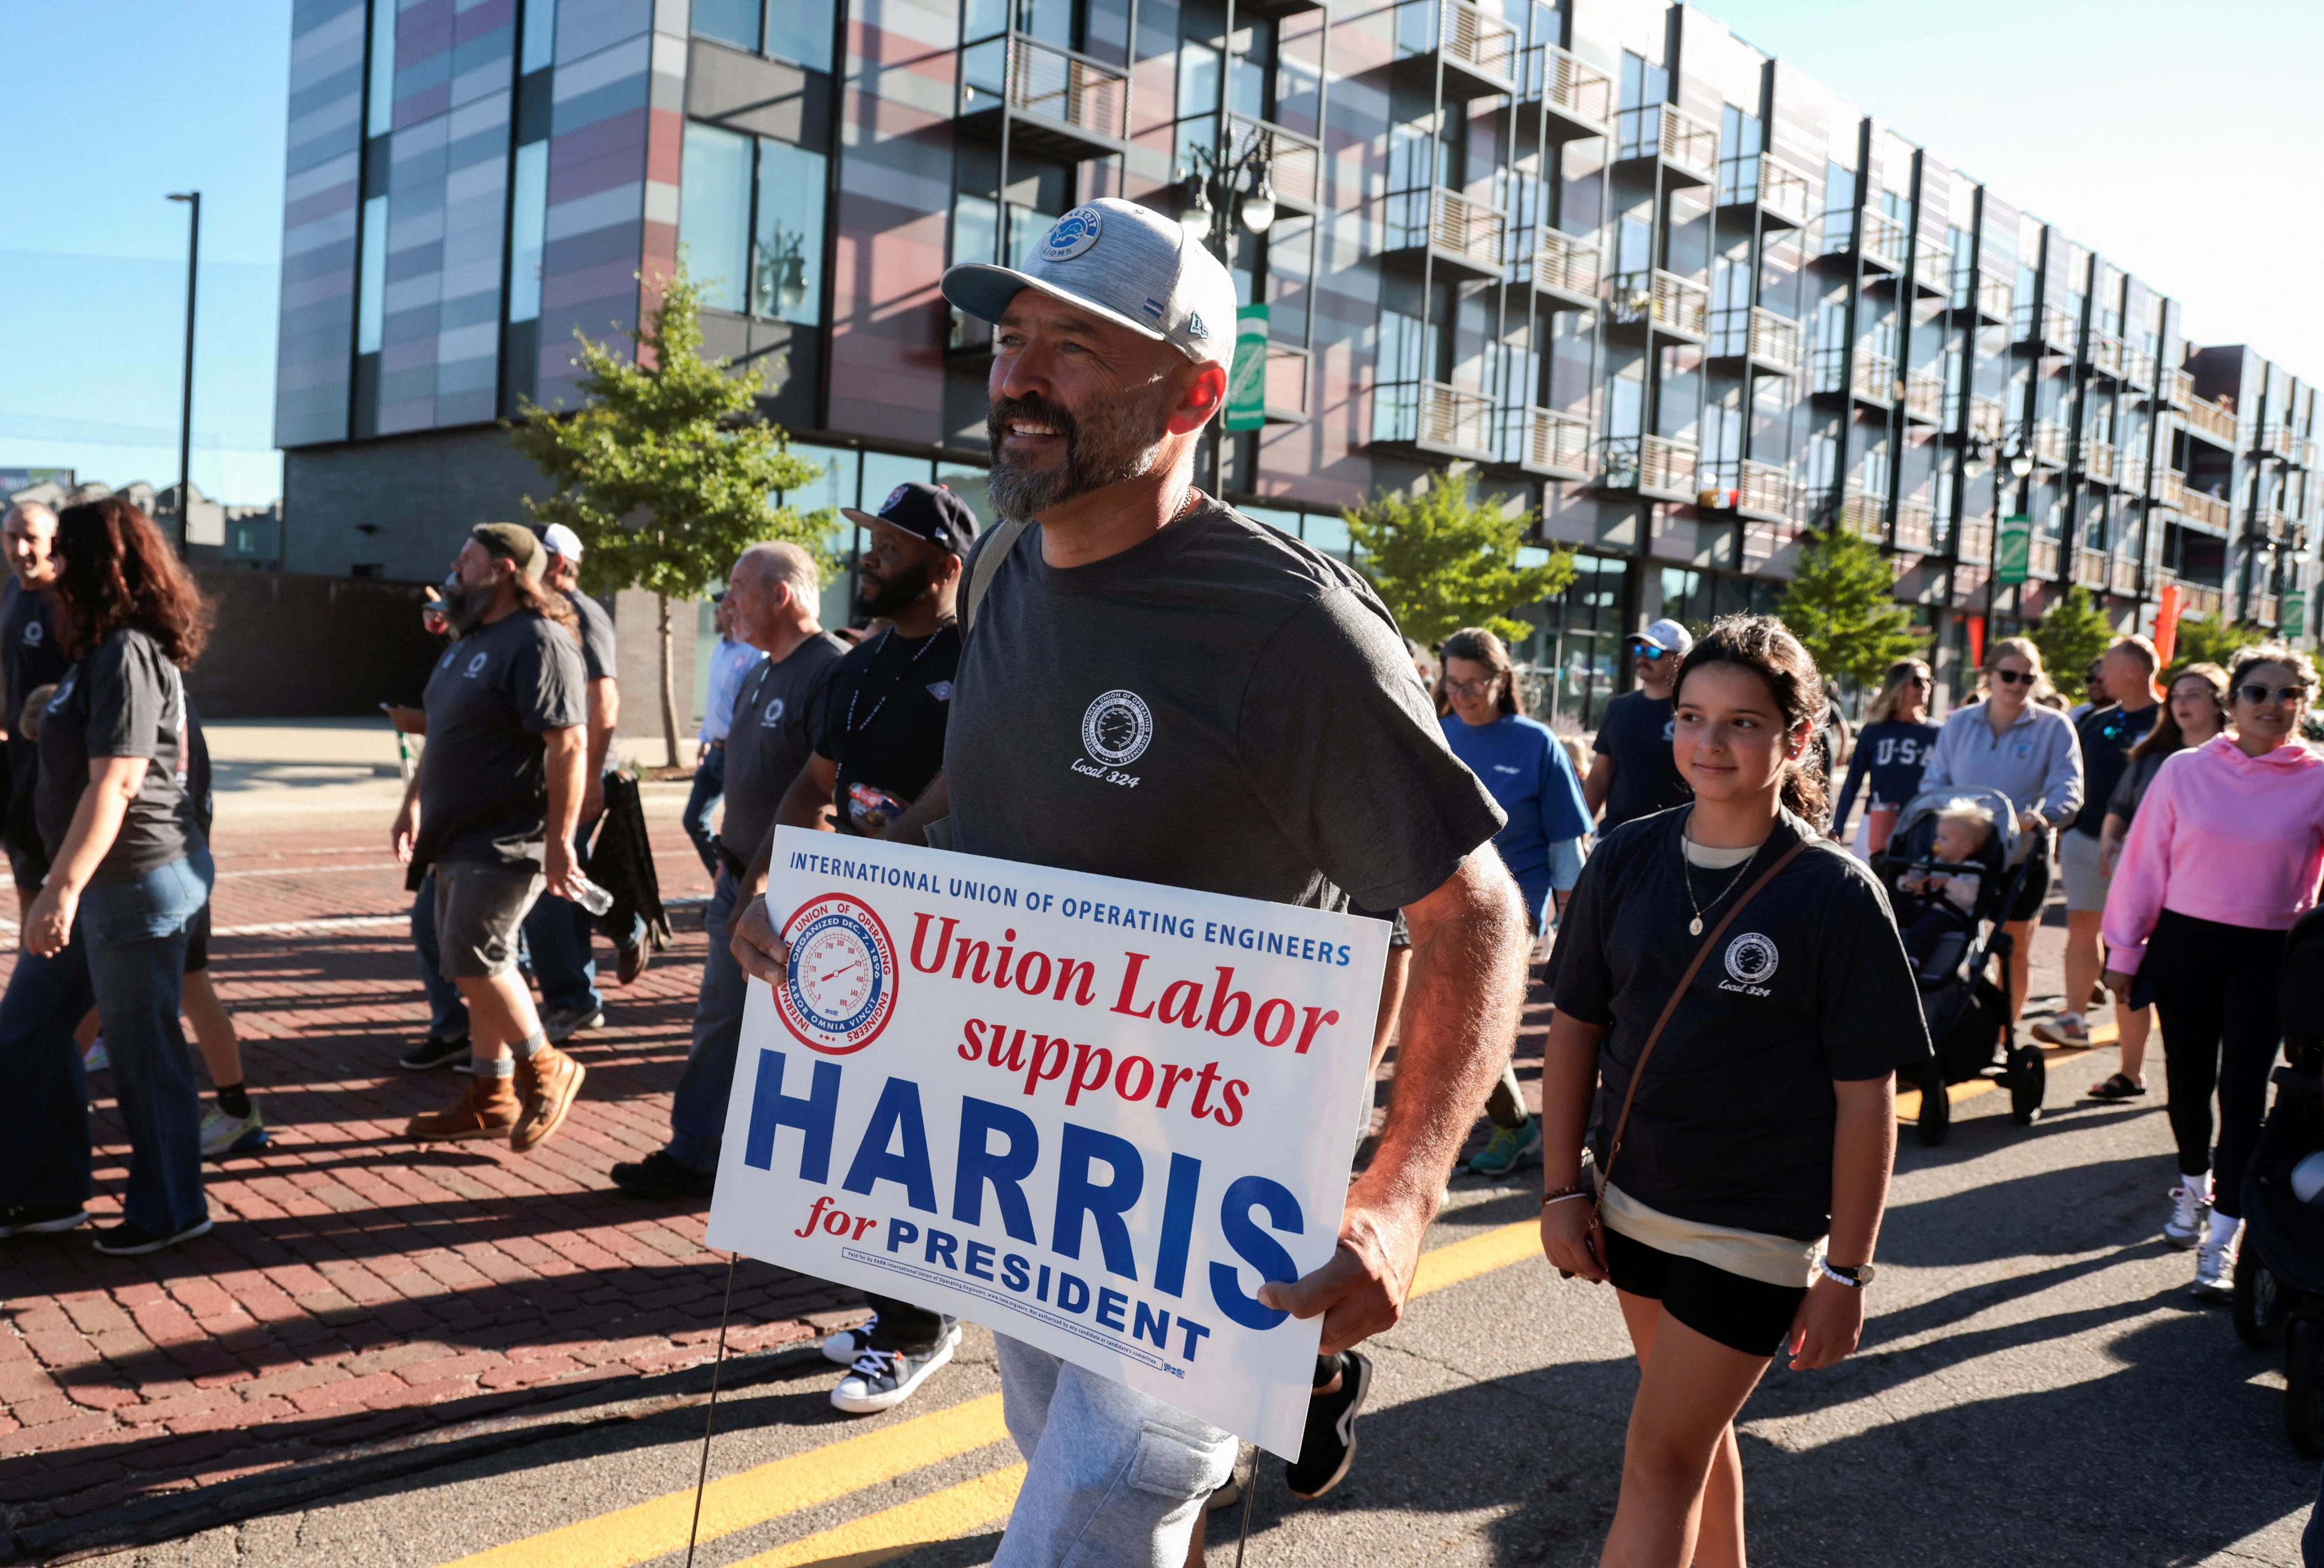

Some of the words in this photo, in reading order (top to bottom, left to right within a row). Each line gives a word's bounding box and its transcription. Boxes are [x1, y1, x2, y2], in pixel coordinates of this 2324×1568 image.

[1043, 247, 1072, 256] LIONS
[1092, 699, 1120, 723] ORGANIZED
[1099, 693, 1121, 704] UNION
[1132, 698, 1150, 733] OPERATING
[1084, 704, 1098, 755] INTERNATIONAL
[1089, 728, 1098, 748] LABOR
[1099, 748, 1118, 757] OMNIA
[1122, 741, 1139, 755] VINCIT
[1119, 736, 1149, 763] ENGINEERS
[1071, 758, 1108, 778] Local
[1106, 770, 1141, 788] 324
[790, 852, 940, 894] INTERNATIONAL
[949, 878, 1017, 907] UNION
[1026, 892, 1054, 913] OF
[1062, 898, 1195, 939] OPERATING
[1205, 922, 1351, 967] ENGINEERS
[795, 904, 829, 932] UNION
[837, 903, 850, 914] OF
[792, 918, 839, 963] ORGANIZED
[842, 919, 860, 934] DEC.
[870, 947, 880, 979] 1896
[858, 912, 891, 975] OPERATING
[790, 978, 809, 1015] LABOR
[810, 1015, 845, 1031] OMNIA
[849, 997, 876, 1027] VINCIT
[910, 912, 1096, 1006] Union
[1109, 952, 1340, 1054] Labor
[1718, 979, 1748, 992] Local
[1746, 985, 1771, 997] 324
[847, 990, 889, 1042] ENGINEERS
[958, 1018, 1250, 1127] supports
[744, 1048, 1304, 1331] HARRIS
[794, 1196, 877, 1241] for
[887, 1217, 1211, 1362] PRESIDENT
[918, 1271, 932, 1280] Union
[939, 1277, 962, 1288] Operating
[963, 1285, 987, 1296] Engineers,
[1038, 1312, 1062, 1325] authorized
[1078, 1328, 1100, 1341] candidate
[1106, 1340, 1132, 1354] candidate's
[1132, 1351, 1157, 1365] committee.
